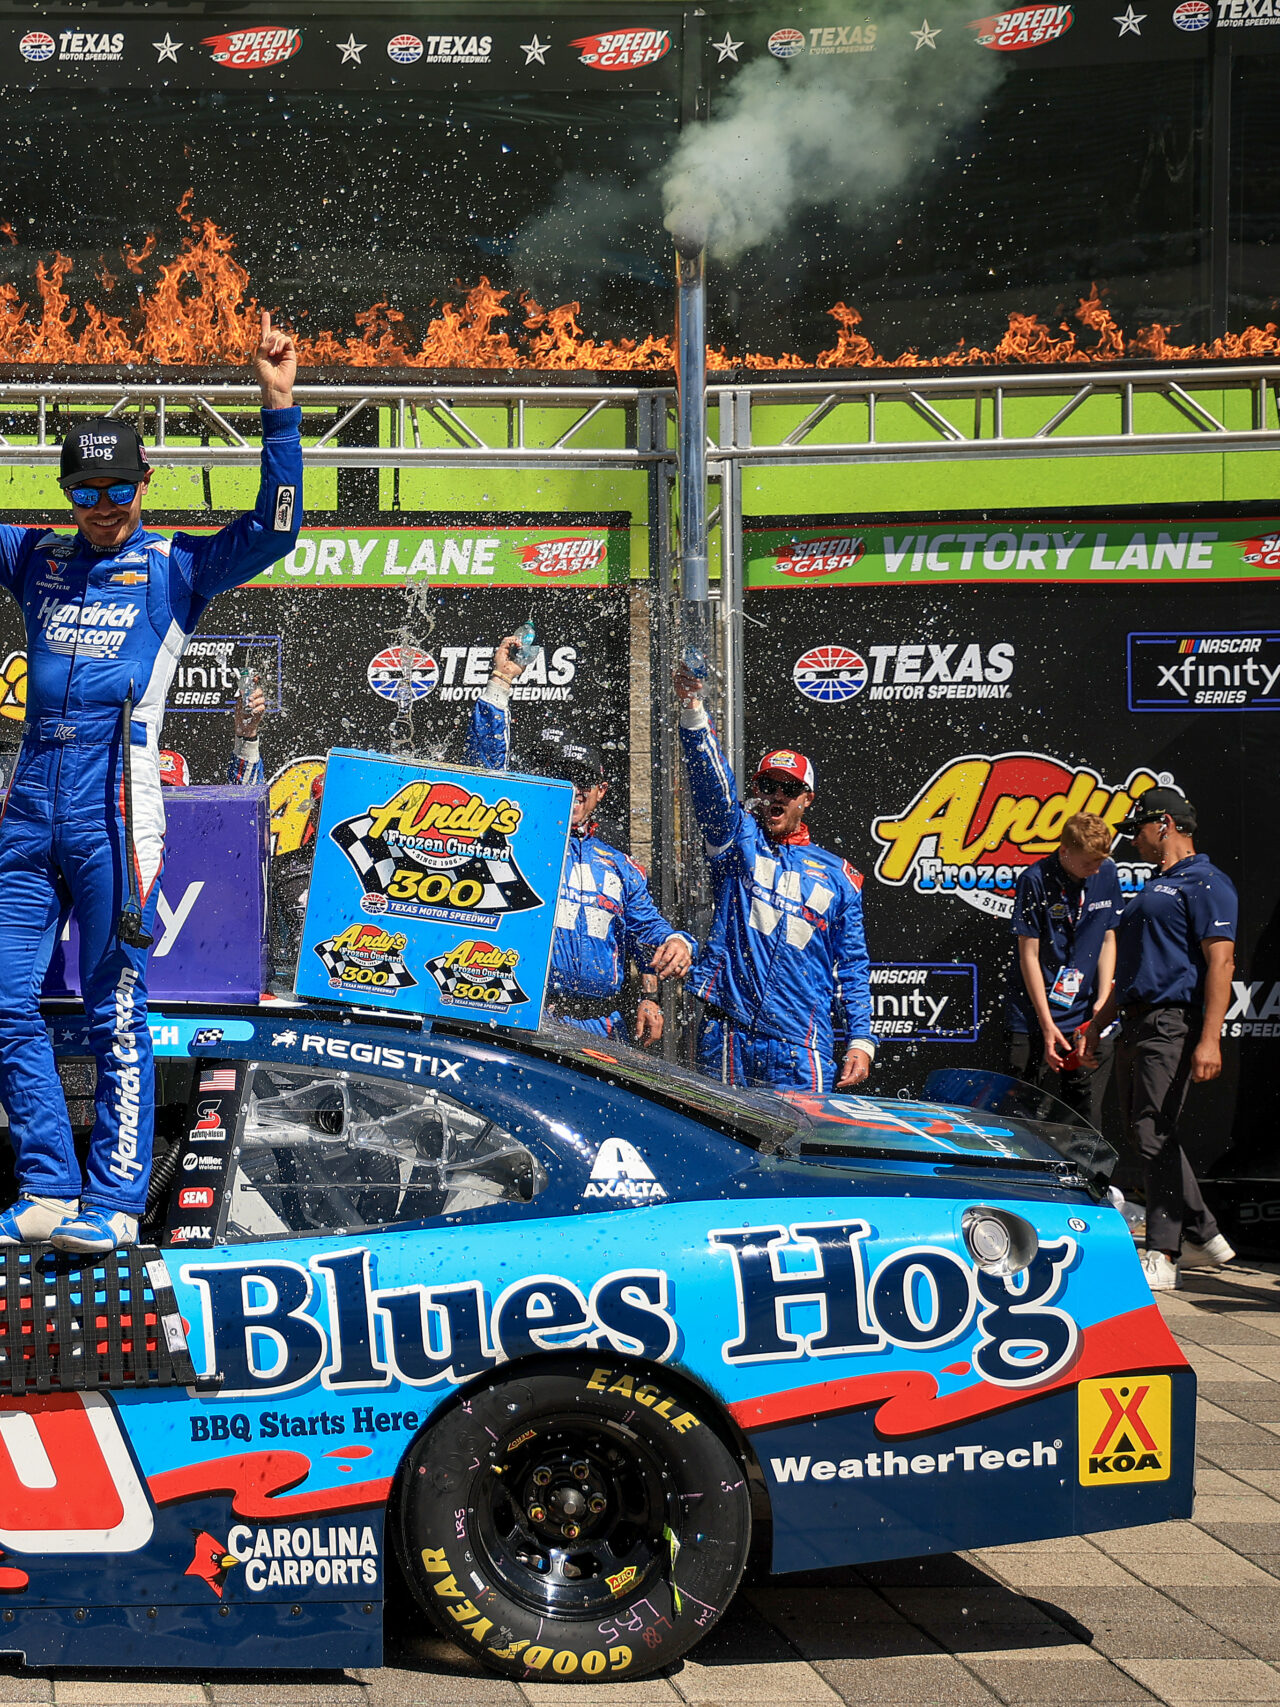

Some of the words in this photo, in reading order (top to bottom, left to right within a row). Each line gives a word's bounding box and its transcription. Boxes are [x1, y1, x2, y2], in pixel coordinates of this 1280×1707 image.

[996, 5, 1072, 33] SPEEDY
[59, 33, 124, 53] TEXAS
[230, 30, 299, 50] SPEEDY
[597, 29, 669, 52] SPEEDY
[809, 25, 877, 51] TEXAS
[998, 22, 1063, 45] CA$H
[232, 46, 293, 64] CA$H
[427, 35, 492, 56] TEXAS
[59, 52, 83, 60] MOTOR
[85, 52, 122, 61] SPEEDWAY
[427, 54, 451, 63] MOTOR
[453, 55, 490, 64] SPEEDWAY
[601, 48, 658, 66] CA$H
[78, 433, 118, 447] Blues
[82, 446, 114, 461] Hog
[383, 539, 501, 576] LANE
[538, 539, 605, 559] SPEEDY
[792, 536, 863, 560] SPEEDY
[882, 532, 1095, 572] VICTORY
[1089, 532, 1218, 570] LANE
[540, 555, 599, 571] CA$H
[794, 554, 857, 572] CA$H
[37, 596, 140, 628] Hendrick
[45, 622, 127, 646] Cars.com
[1198, 638, 1262, 653] NASCAR
[440, 646, 577, 686] TEAS
[869, 644, 1015, 684] TEXAS
[1158, 656, 1280, 697] xfinity
[175, 692, 221, 705] SERIES
[440, 687, 487, 701] MOTO
[870, 685, 924, 700] MOTOR
[927, 684, 1009, 699] SPEEDWAY
[1194, 690, 1246, 704] SERIES
[369, 782, 521, 839] Andy's
[877, 760, 1157, 881] Andy'
[387, 829, 443, 854] Frozen
[446, 838, 511, 862] Custard
[416, 853, 437, 867] SINCE
[387, 869, 483, 907] 300
[390, 903, 418, 914] TEXAS
[418, 906, 449, 919] MOTOR
[449, 910, 496, 925] SPEEDWAY
[333, 924, 407, 952] Andy's
[342, 948, 370, 960] Frozen
[371, 951, 402, 963] Custard
[444, 940, 519, 968] Andy's
[342, 967, 389, 985] 300
[453, 965, 482, 976] Frozen
[482, 968, 514, 980] Custard
[869, 969, 928, 984] NASCAR
[371, 986, 395, 995] SPEEDWAY
[453, 983, 501, 1002] 300
[483, 1003, 507, 1012] SPEEDWAY
[869, 1020, 914, 1034] SERIES
[301, 1034, 465, 1083] REGISTIX
[190, 1129, 225, 1140] safety-kleen
[198, 1156, 223, 1165] Miller
[183, 1191, 208, 1204] SEM
[584, 1181, 667, 1199] AXALTA
[181, 1247, 678, 1398] Blues
[708, 1219, 1078, 1388] Hog
[586, 1367, 700, 1434] EAGLE
[190, 1414, 252, 1441] BBQ
[260, 1410, 346, 1438] Starts
[352, 1406, 419, 1431] Here
[770, 1442, 1058, 1483] WeatherTech
[1089, 1452, 1160, 1474] KOA
[227, 1524, 378, 1563] CAROLINA
[245, 1558, 378, 1591] CARPORTS
[422, 1547, 633, 1675] GOODYEAR
